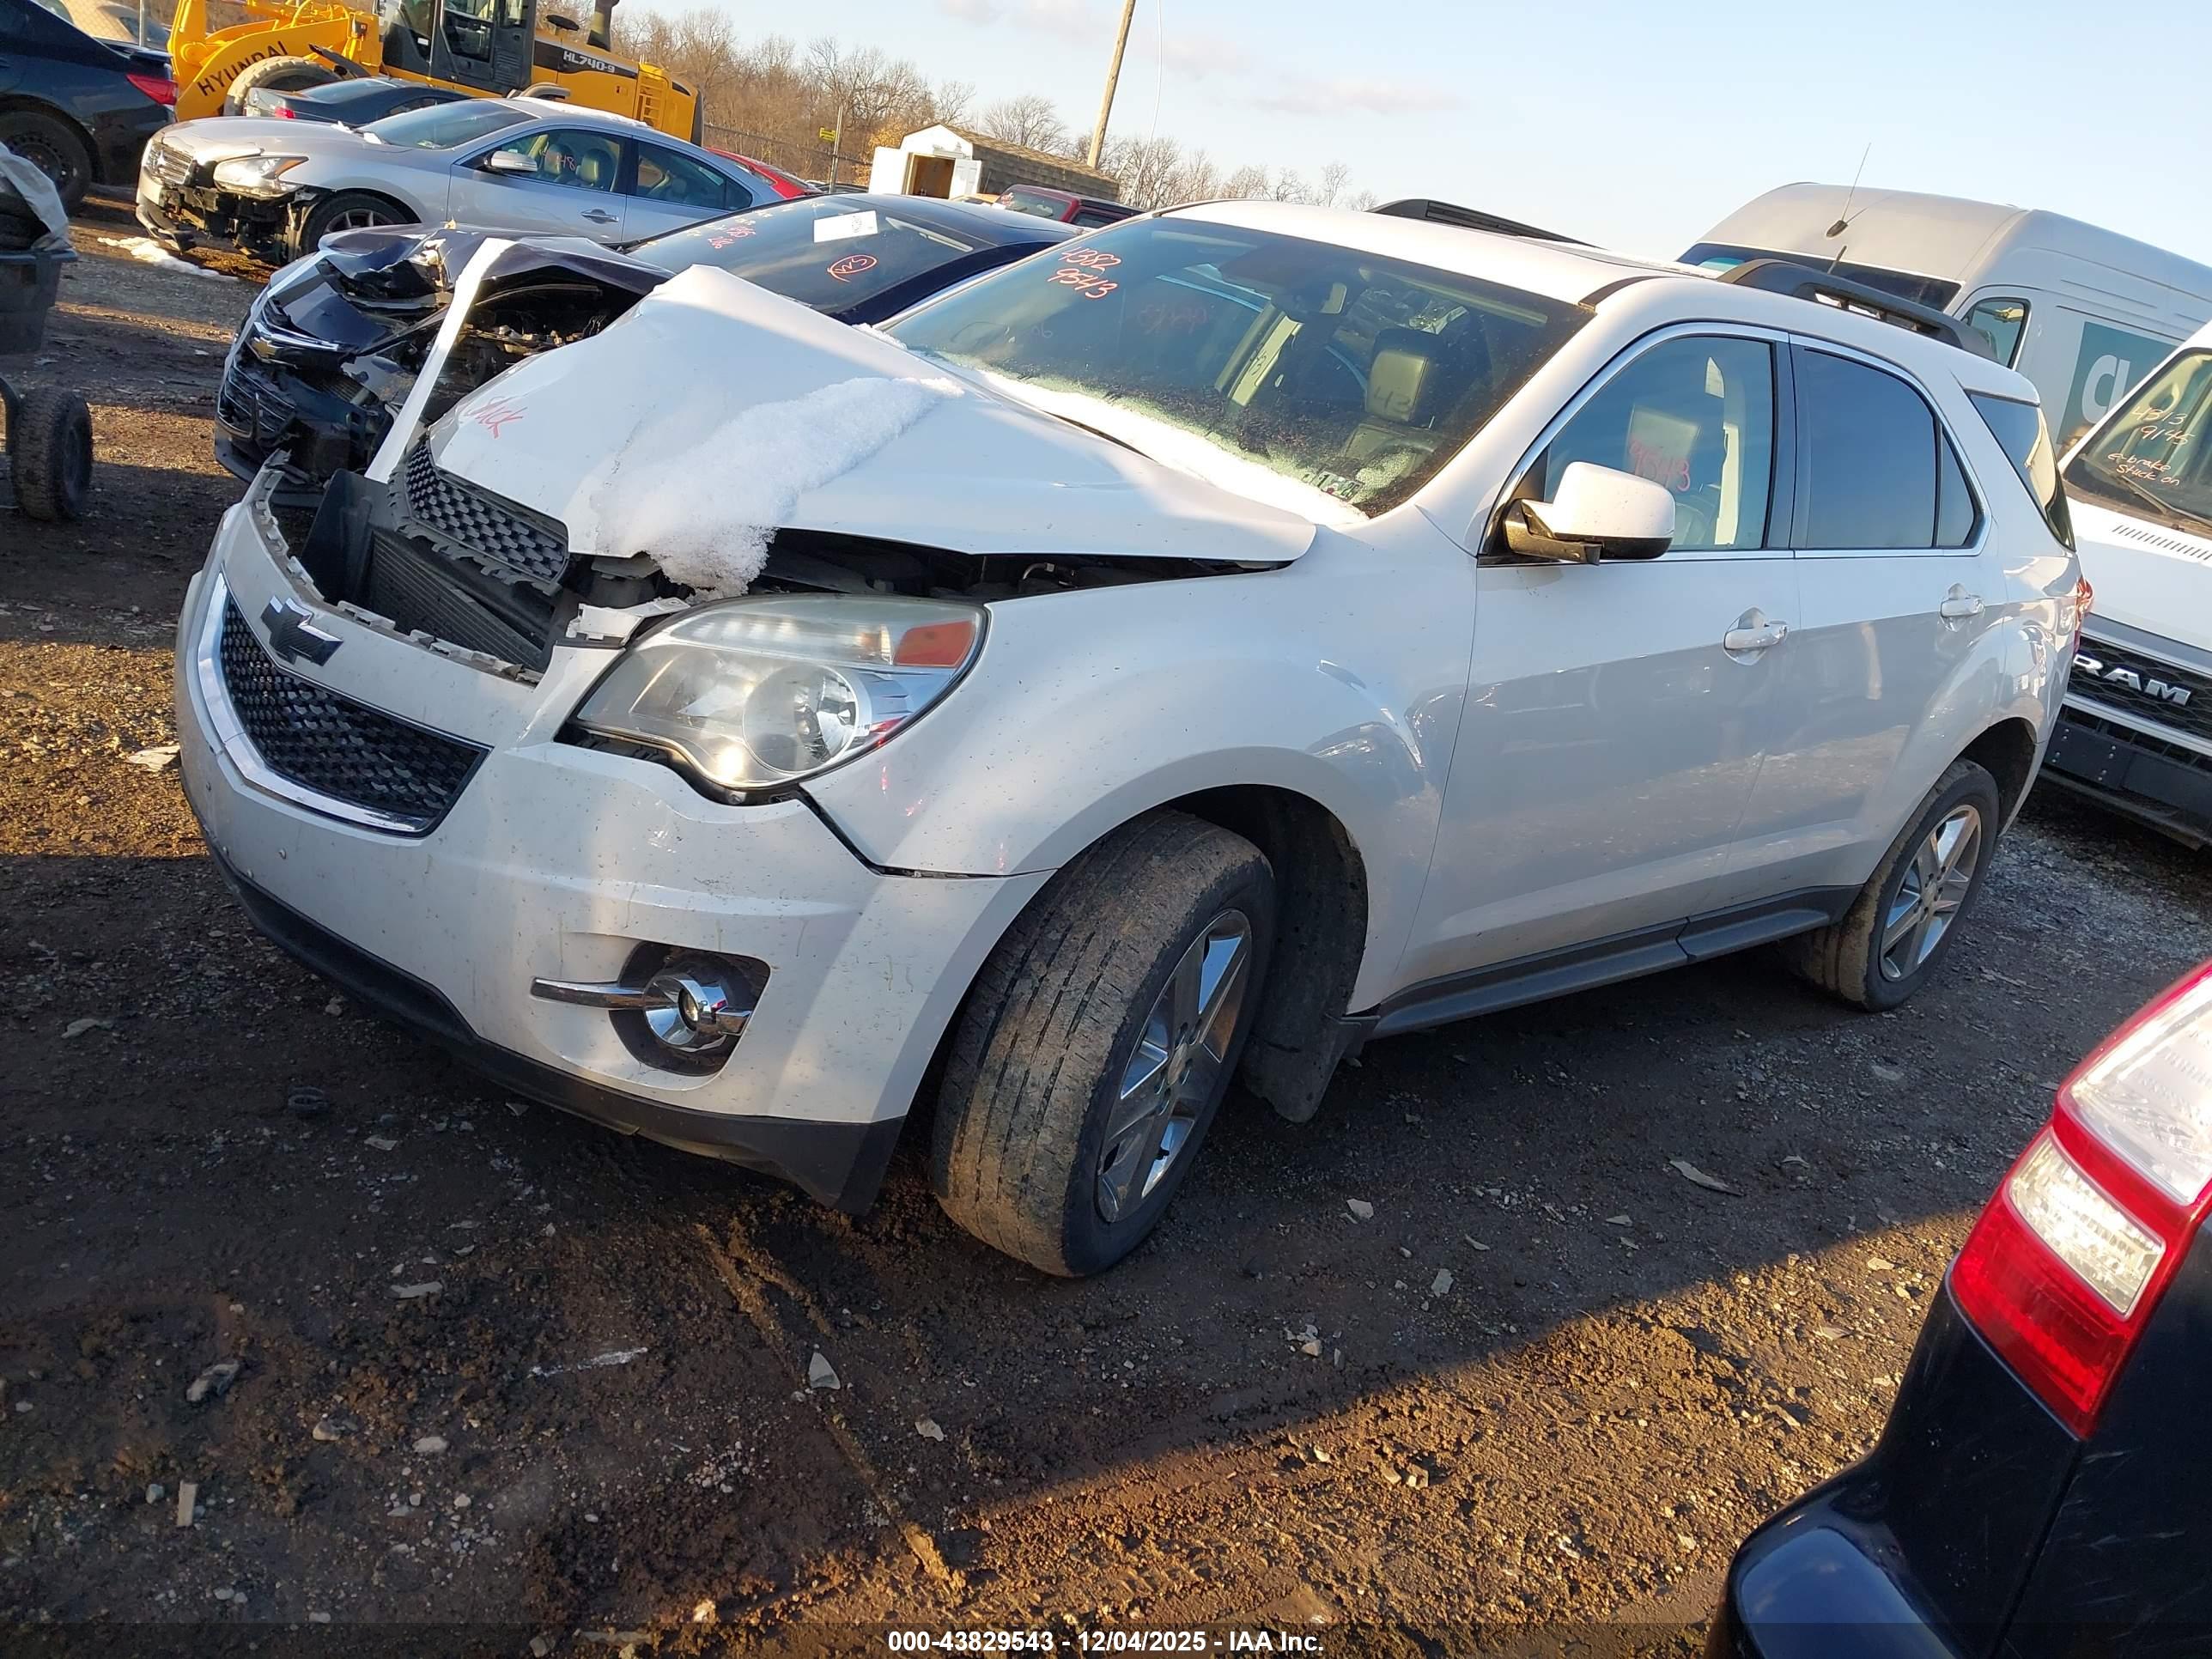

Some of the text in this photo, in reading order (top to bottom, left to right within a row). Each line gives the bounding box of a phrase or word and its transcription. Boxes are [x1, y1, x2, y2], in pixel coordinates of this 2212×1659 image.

[197, 40, 289, 96] HYUNDAI
[563, 51, 616, 73] HL740-9
[1058, 246, 1121, 275] 4382
[1047, 267, 1119, 299] 9543
[2131, 406, 2188, 425] 4313
[2141, 425, 2196, 446] 9145
[2107, 453, 2172, 472] e-brake
[2160, 475, 2180, 487] on
[2073, 653, 2191, 707] RAM
